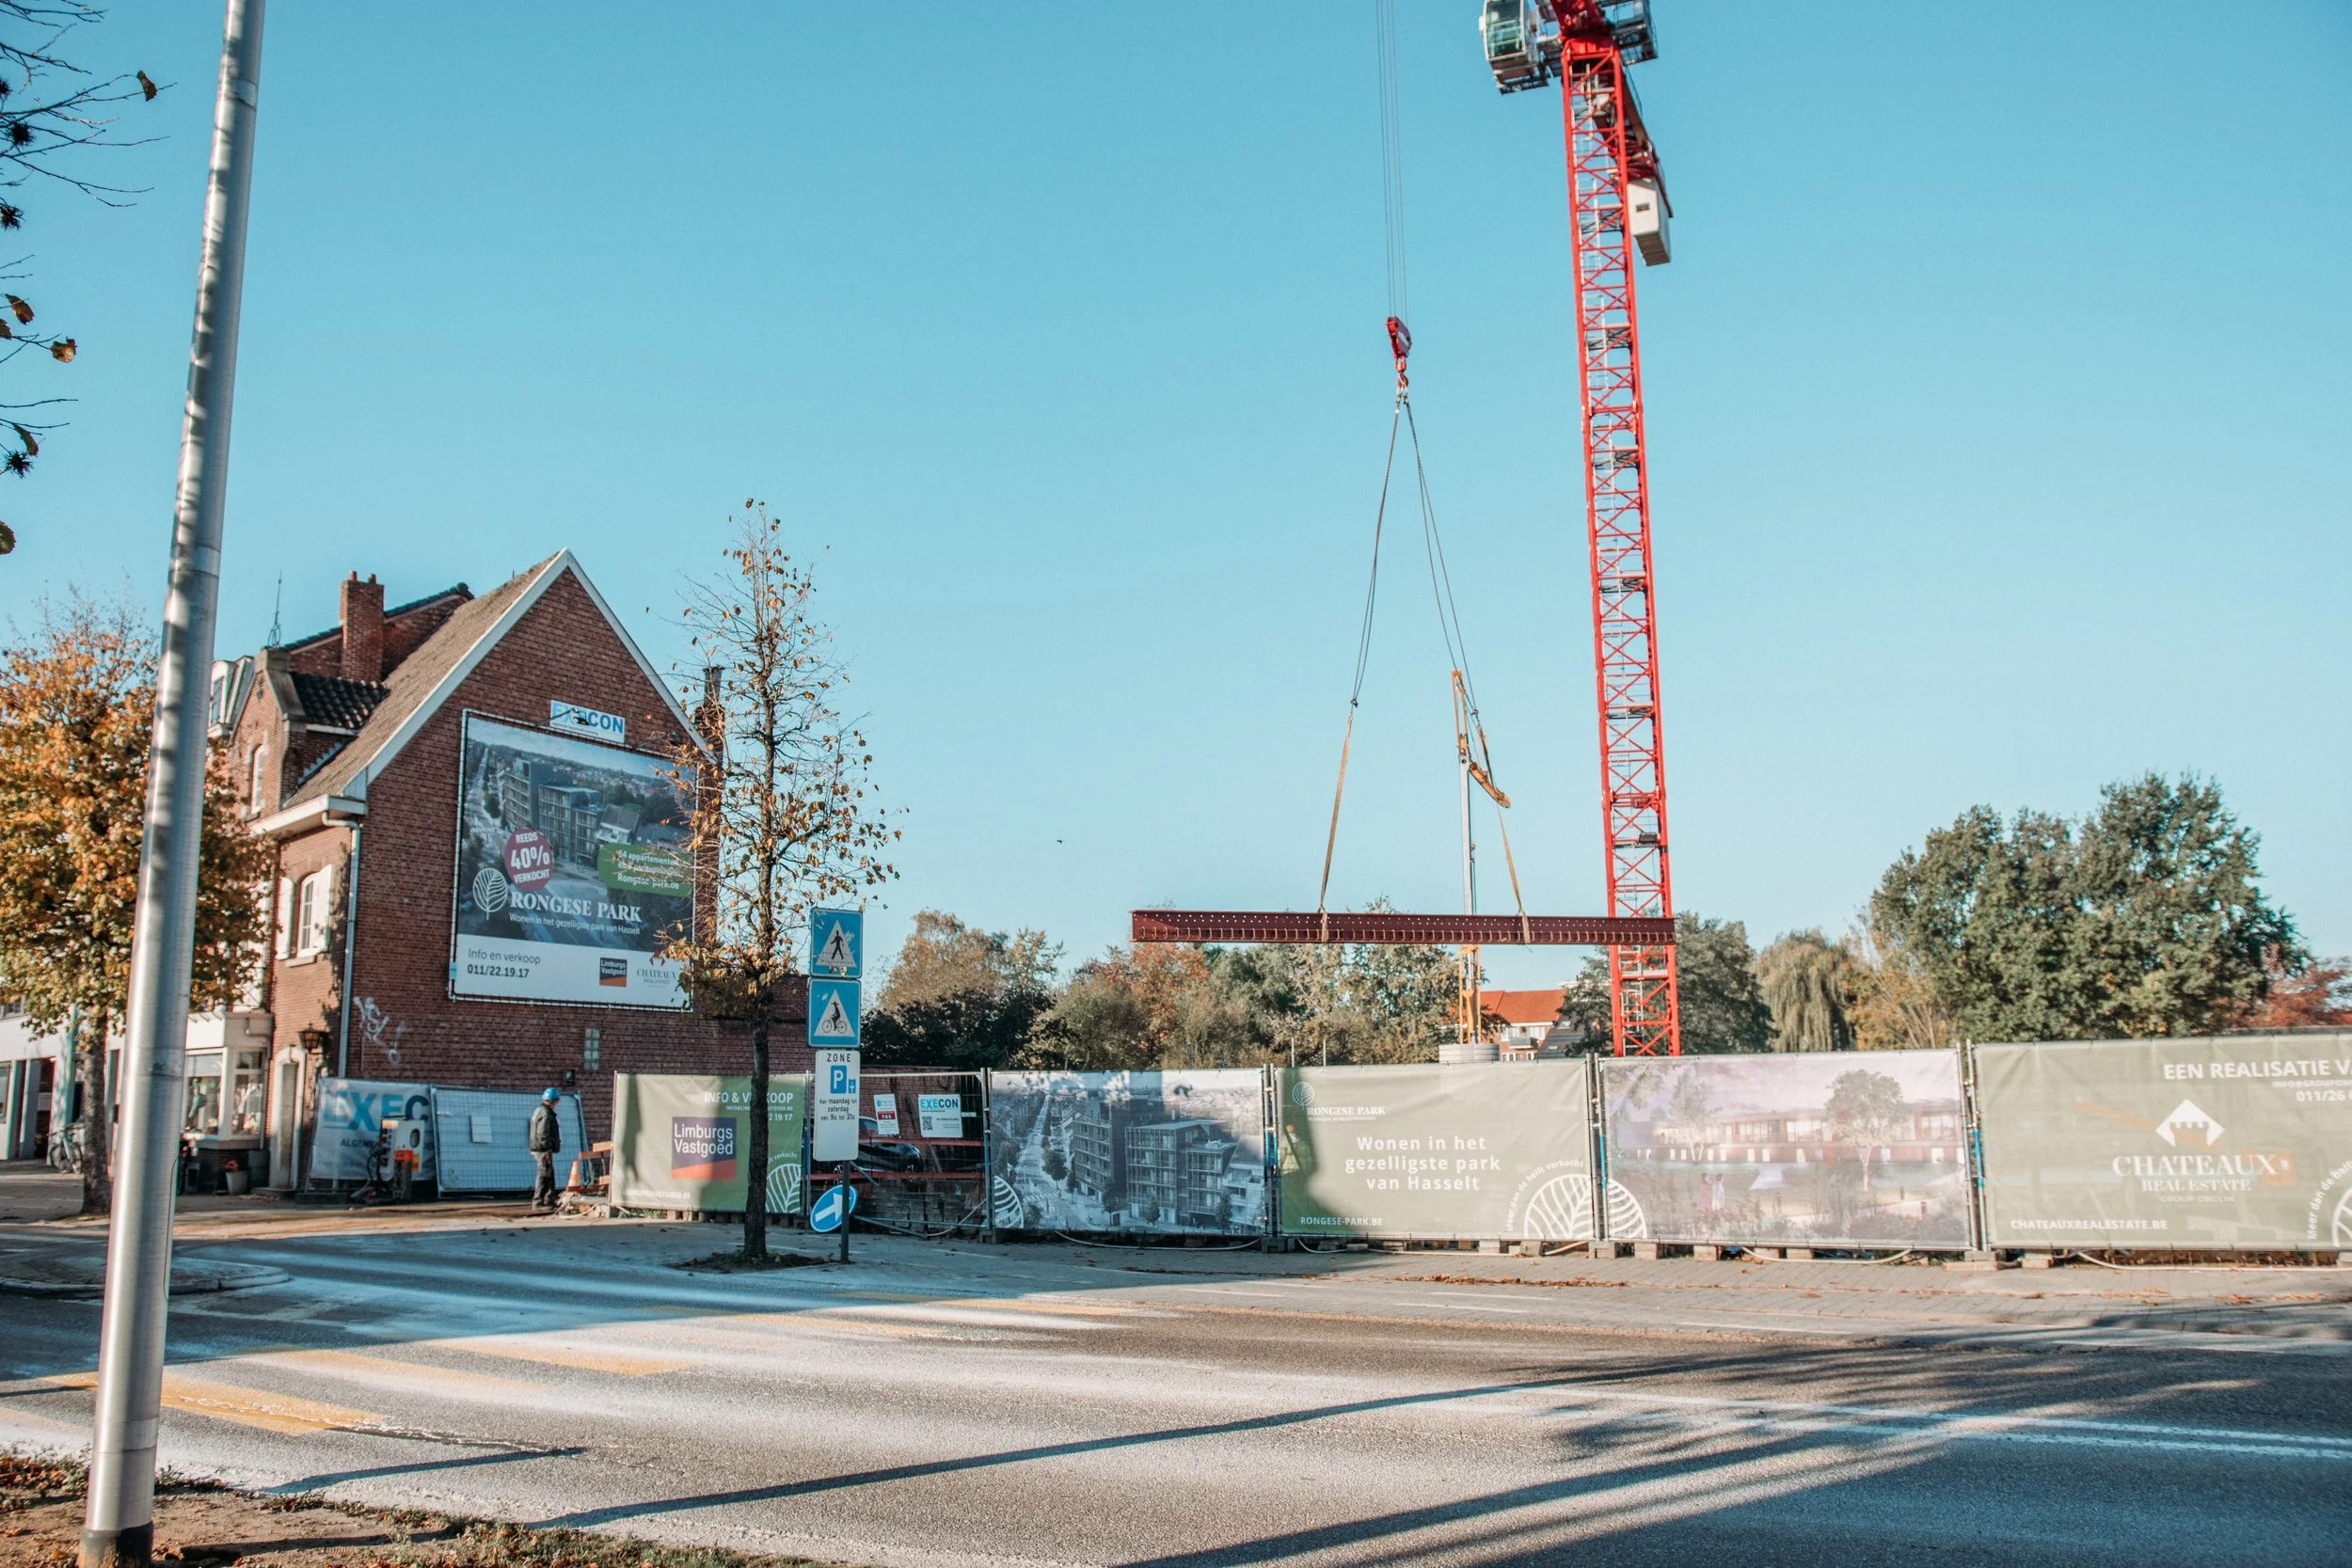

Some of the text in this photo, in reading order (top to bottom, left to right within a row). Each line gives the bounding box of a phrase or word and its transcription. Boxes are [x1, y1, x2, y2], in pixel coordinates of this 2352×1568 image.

[552, 703, 624, 734] EXCON
[516, 832, 538, 844] REEDS
[511, 846, 550, 869] 40%
[514, 869, 549, 883] VERKOCHT
[510, 890, 643, 923] RONGESE PARK
[509, 912, 533, 924] Wonen
[534, 916, 542, 925] in
[543, 916, 553, 926] het
[555, 919, 590, 930] gezelligste
[591, 923, 605, 932] park
[618, 926, 640, 934] Hasselt
[468, 948, 487, 959] Info
[503, 952, 541, 965] verkoop
[467, 964, 530, 978] 011/22.19.17
[601, 959, 627, 969] Limburgs
[601, 967, 627, 975] Vastgoed
[636, 969, 676, 979] CHATEAUX
[827, 1053, 851, 1063] ZONE
[2164, 1059, 2352, 1080] EEN REALISATIE V
[834, 1069, 844, 1089] P
[704, 1092, 794, 1103] INFO & VOOP
[2296, 1090, 2346, 1102] 011/26
[920, 1099, 959, 1109] EXECON
[1307, 1105, 1386, 1116] RONGESE PARK
[774, 1113, 782, 1121] 19
[785, 1113, 793, 1121] 17
[674, 1123, 733, 1143] Limburgs
[674, 1138, 733, 1158] Vastgoed
[1357, 1135, 1486, 1150] Wonen in het
[1344, 1155, 1501, 1174] gezelligste park
[2112, 1154, 2280, 1177] CHATEAUX
[1366, 1176, 1480, 1190] van Hasselt
[2141, 1179, 2251, 1192] REAL ESTATE
[2320, 1178, 2335, 1191] de
[1506, 1159, 1584, 1232] Meer dan de helft verkocht
[2311, 1191, 2326, 1211] dan
[1300, 1216, 1384, 1227] RONGESE-PARK.BE
[2010, 1219, 2169, 1230] CHATEAUXREALESTATE.BE
[2307, 1212, 2318, 1239] Meer
